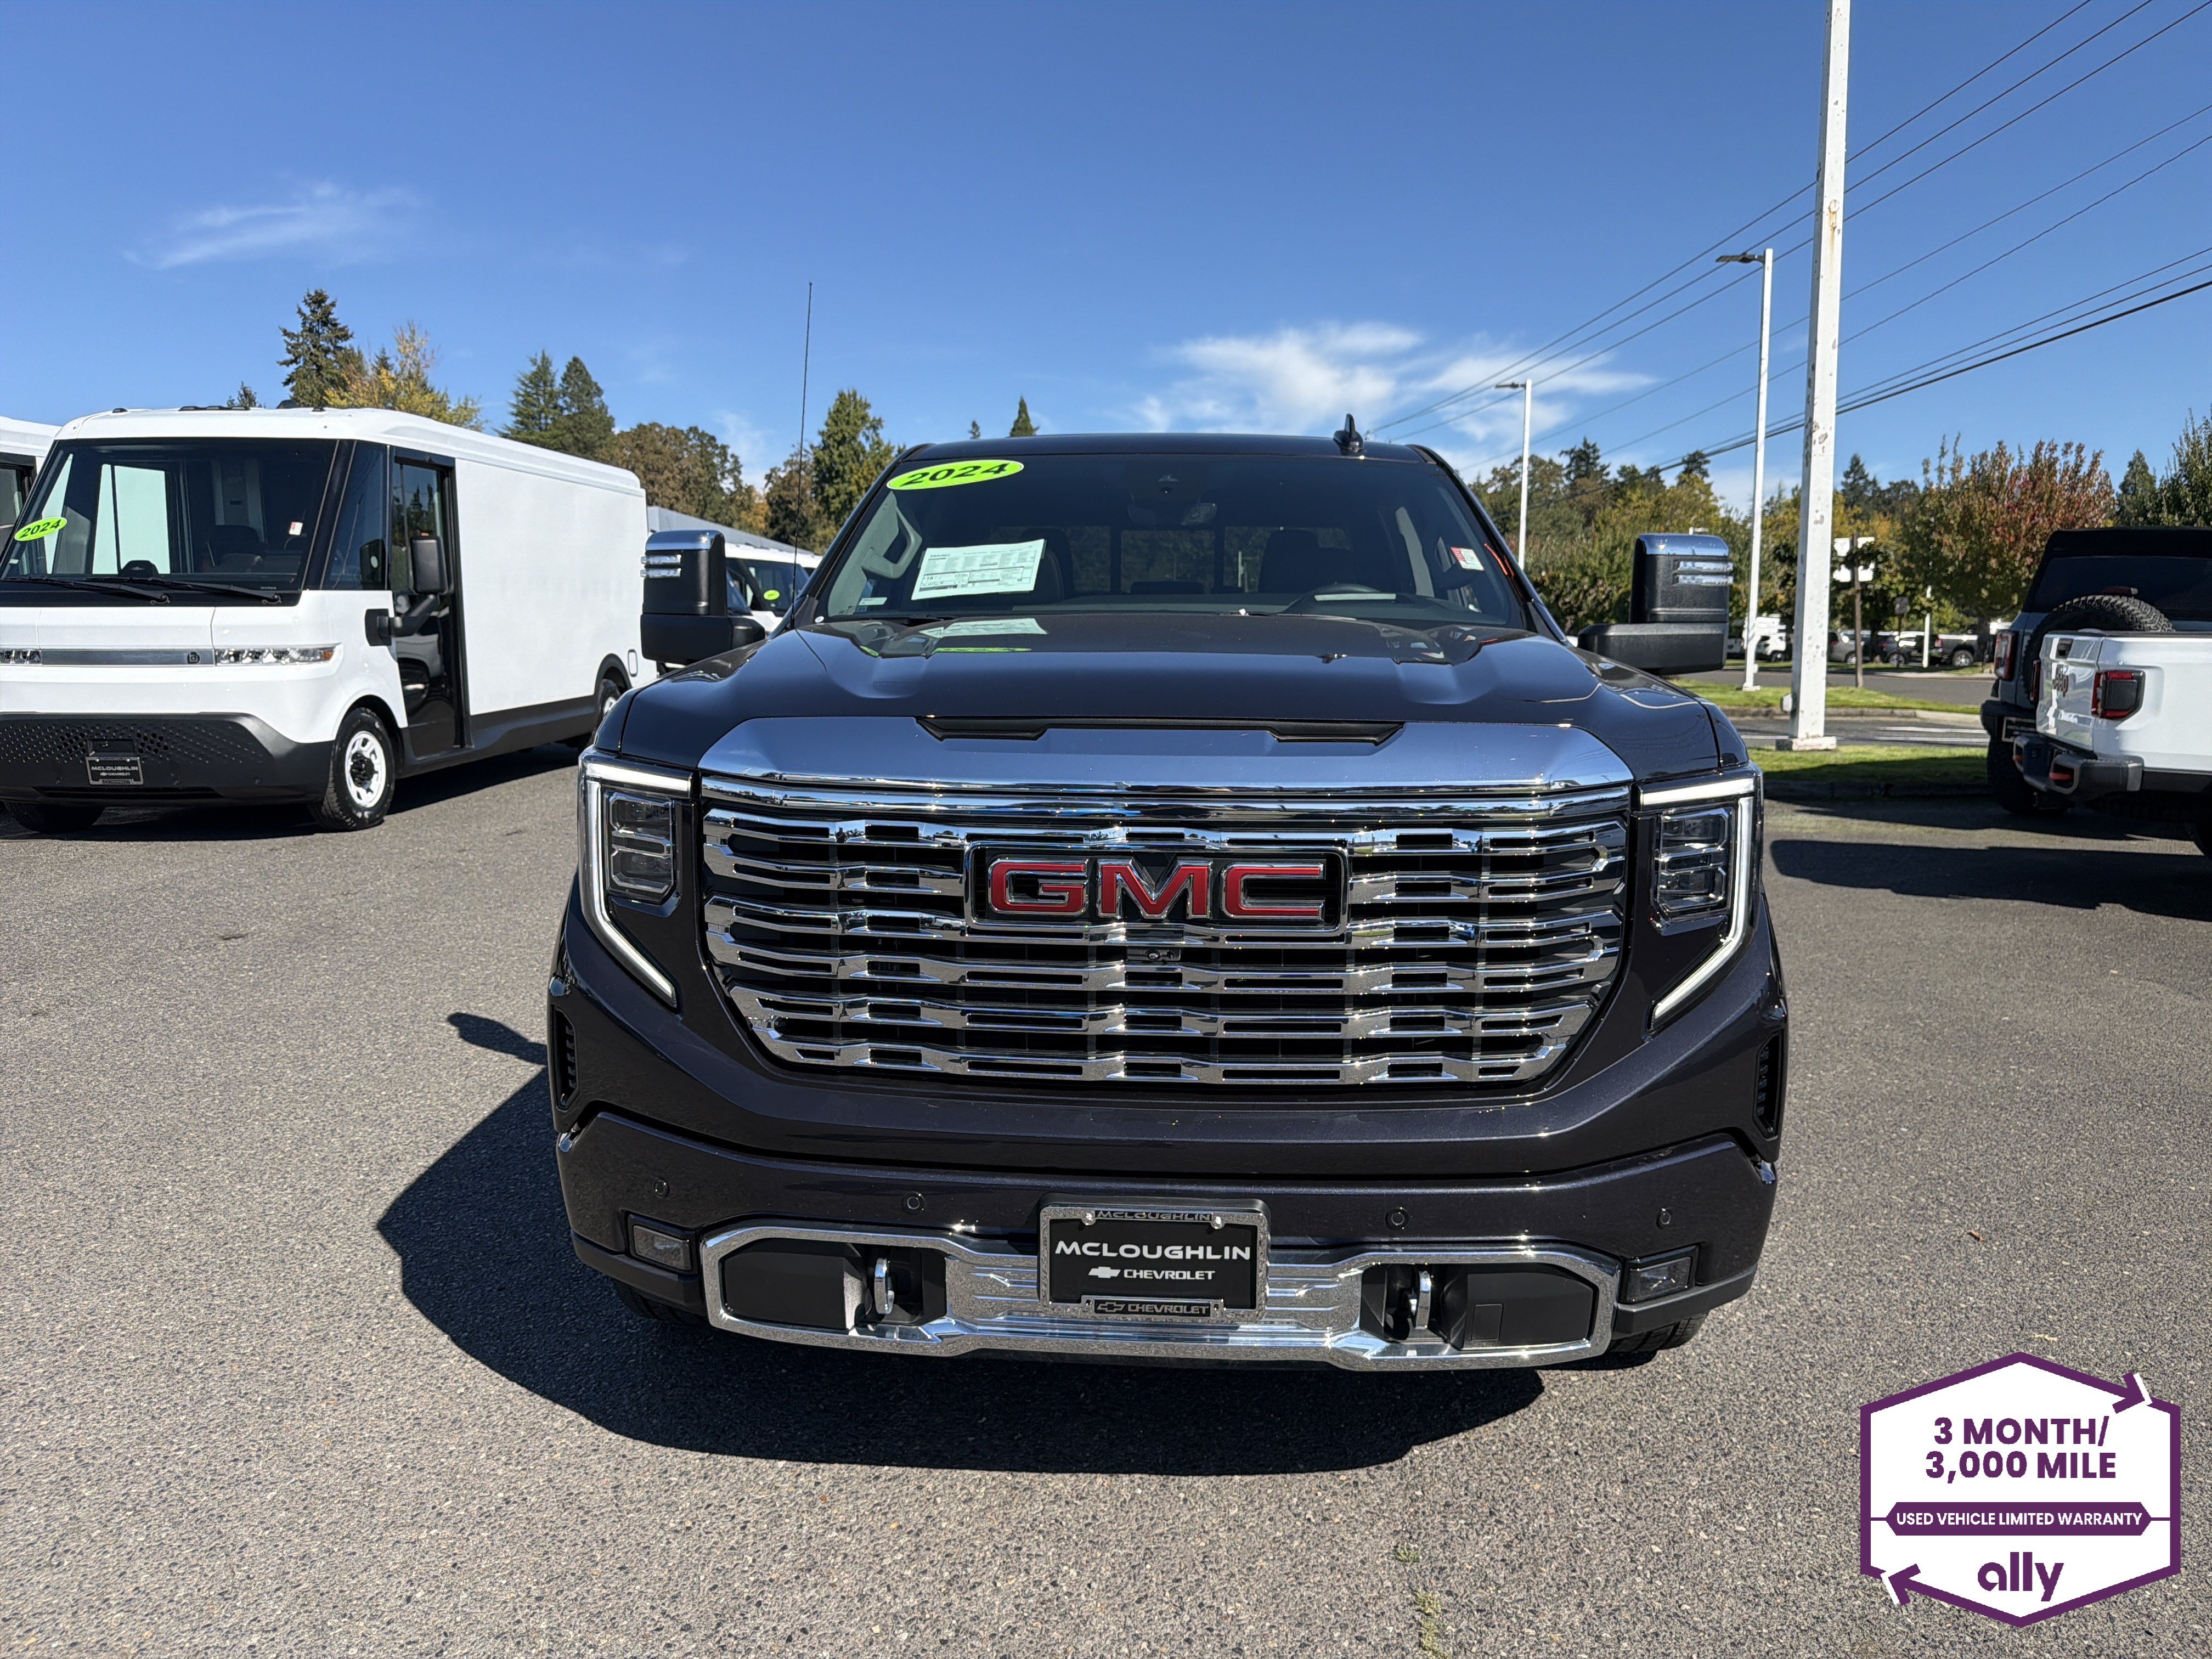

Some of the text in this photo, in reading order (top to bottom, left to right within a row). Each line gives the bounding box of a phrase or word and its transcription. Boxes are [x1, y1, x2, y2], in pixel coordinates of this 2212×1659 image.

[899, 462, 1011, 488] 2024
[19, 518, 62, 539] 2024
[987, 856, 1327, 922] GMC
[1097, 1210, 1211, 1221] MCLOUGHLIN
[1054, 1240, 1251, 1261] MCLOUGHLIN
[1124, 1269, 1216, 1280] CHEVROLET
[1127, 1304, 1210, 1314] CHEVROLET
